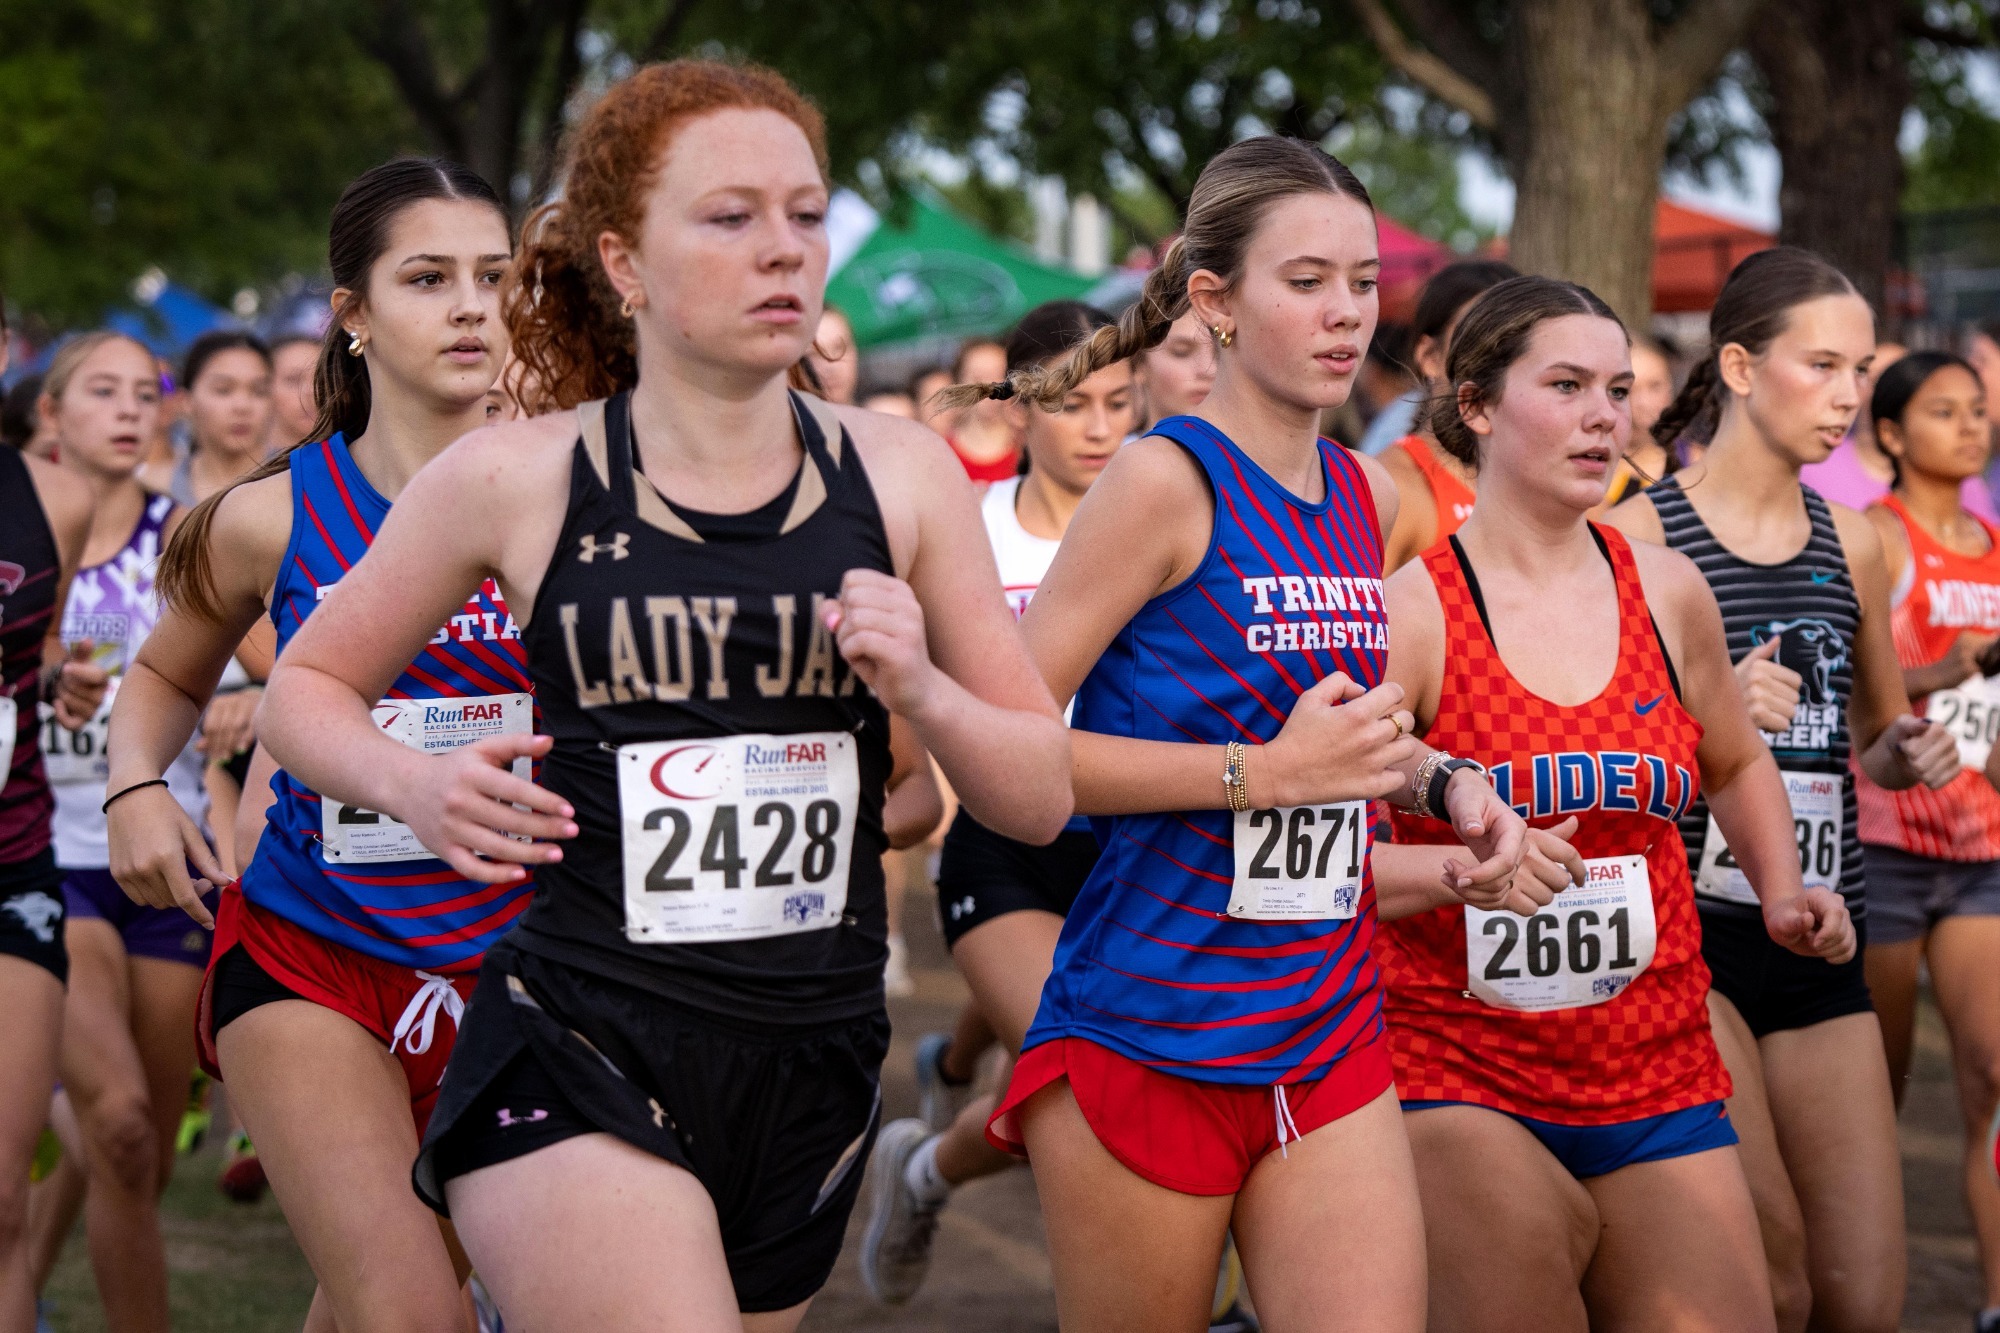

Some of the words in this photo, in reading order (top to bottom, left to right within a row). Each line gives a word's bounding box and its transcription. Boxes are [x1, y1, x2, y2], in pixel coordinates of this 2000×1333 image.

[1243, 575, 1388, 614] TRINITY
[1247, 621, 1390, 653] CHRISTIA
[559, 595, 738, 709] LADY
[755, 592, 866, 698] JA
[424, 703, 503, 724] RunFAR
[461, 720, 503, 729] SERVICES
[424, 738, 482, 749] ESTABLISHE
[744, 742, 827, 765] RunFAR
[745, 785, 808, 797] ESTABLISHED
[1488, 751, 1692, 824] LIDELL
[1789, 778, 1834, 795] RunFAR
[643, 798, 841, 892] 2428
[1248, 807, 1360, 880] 2671
[1558, 898, 1609, 908] ESTABLISHED
[1482, 907, 1637, 981] 2661
[1593, 974, 1633, 993] COWTOWN
